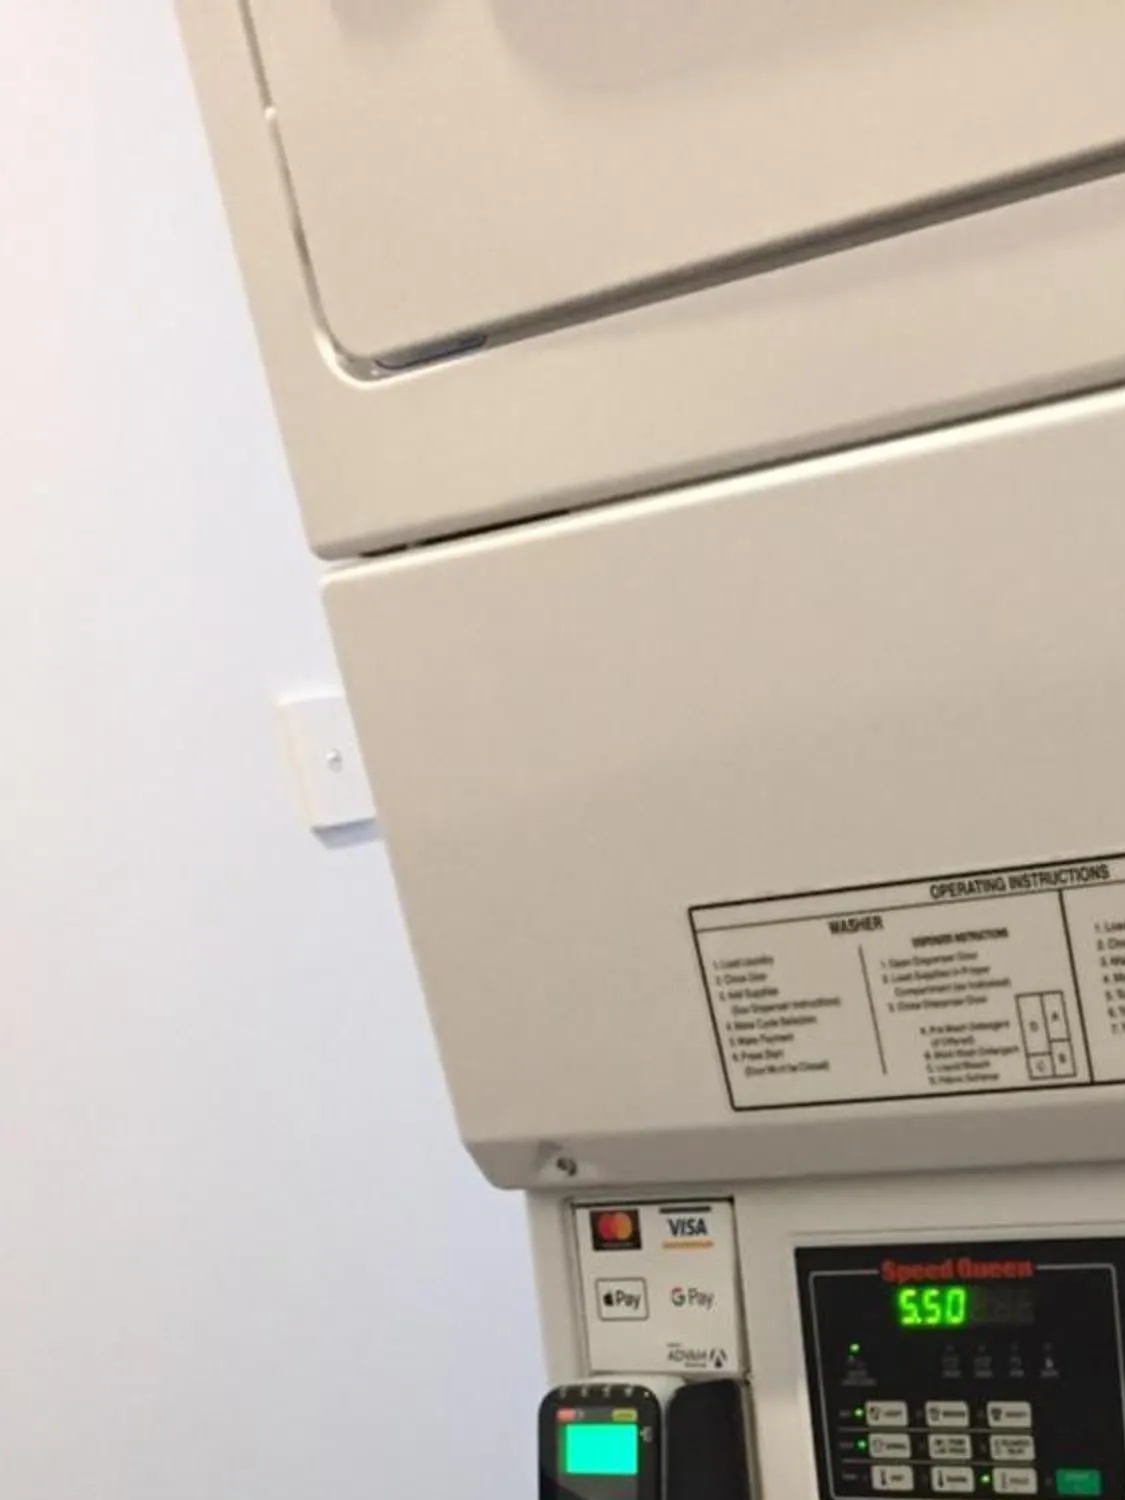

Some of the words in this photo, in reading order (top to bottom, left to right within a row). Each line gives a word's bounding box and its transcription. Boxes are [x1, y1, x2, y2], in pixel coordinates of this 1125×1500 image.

[929, 876, 1006, 900] OPERATING
[1008, 864, 1111, 891] INSTRUCTIONS
[828, 915, 884, 935] WASHER
[666, 1217, 708, 1238] VISA
[881, 1259, 954, 1283] Speed
[957, 1257, 1034, 1279] Queen
[615, 1289, 642, 1311] Pay
[687, 1287, 714, 1311] Pay
[899, 1286, 967, 1326] 5.50
